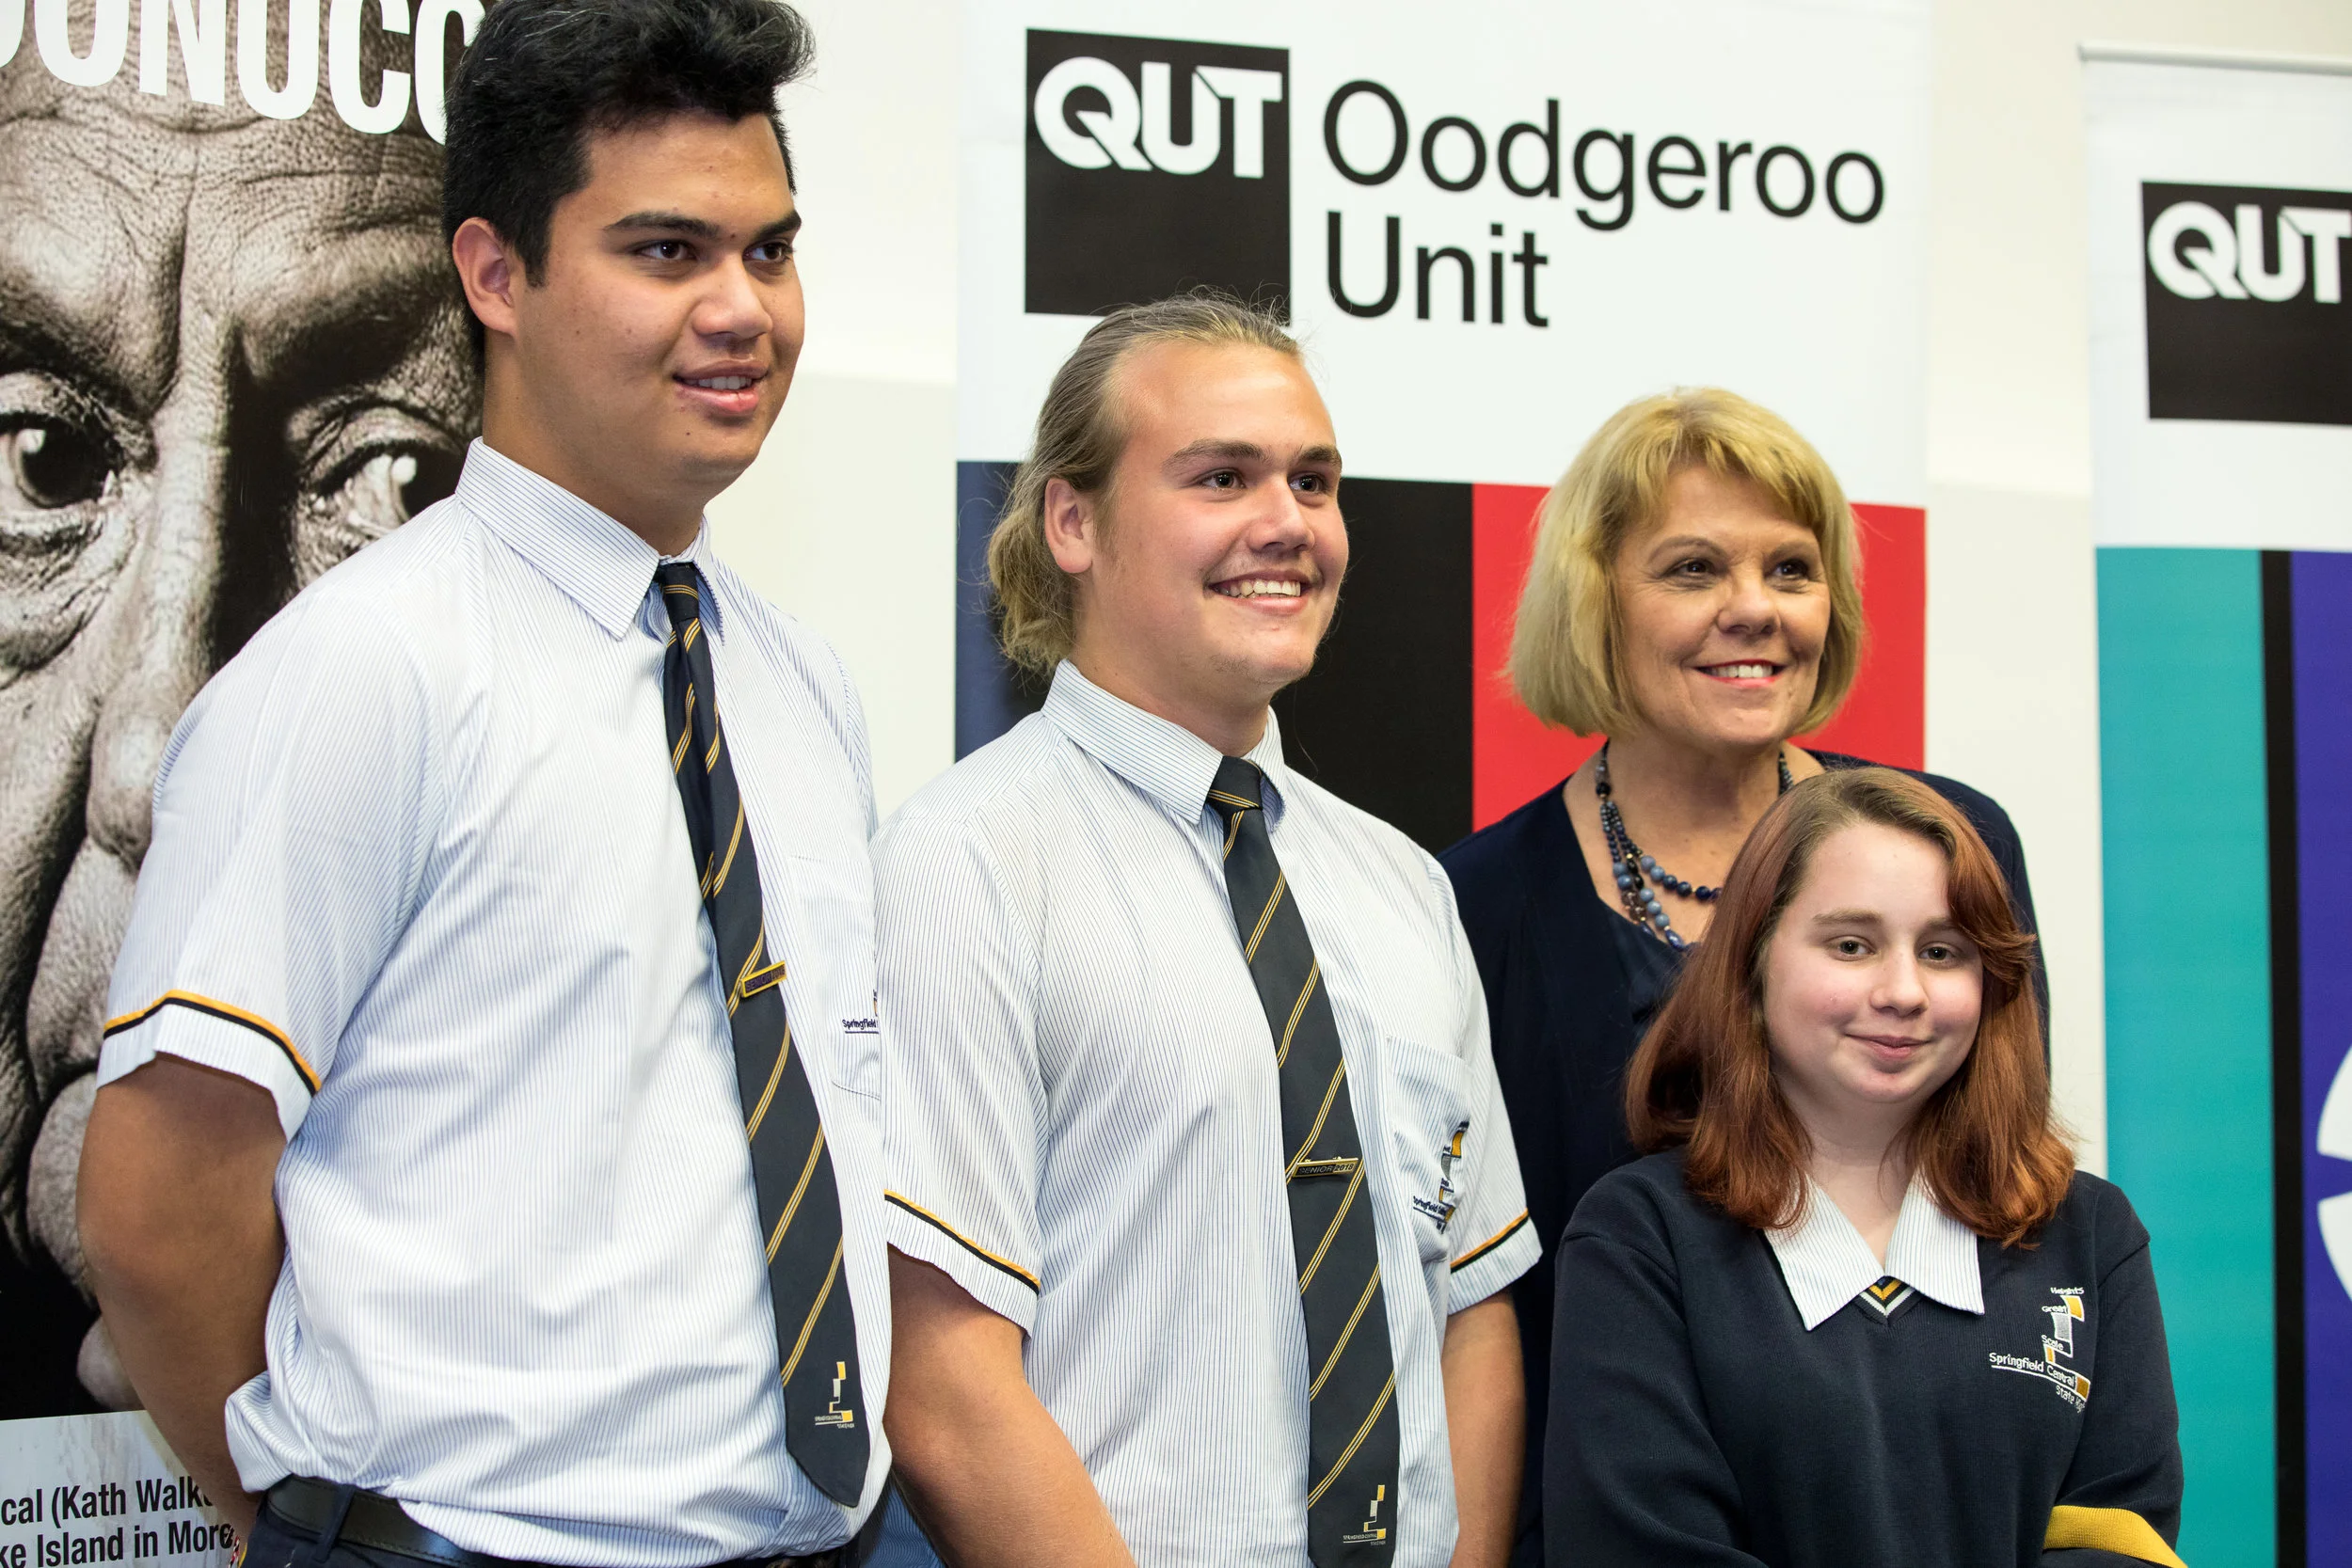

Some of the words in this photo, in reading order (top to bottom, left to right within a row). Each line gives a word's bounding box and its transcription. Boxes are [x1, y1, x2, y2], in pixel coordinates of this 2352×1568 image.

[1034, 56, 1282, 179] QUT
[1323, 80, 1884, 231] Oodgeroo
[1327, 211, 1549, 327] Unit
[2148, 200, 2352, 304] QUT
[1989, 1352, 2044, 1372] Springfield
[2046, 1365, 2074, 1387] Central
[2056, 1385, 2075, 1404] State
[52, 1482, 127, 1528] (Kath
[37, 1527, 123, 1568] Island
[134, 1525, 159, 1558] in
